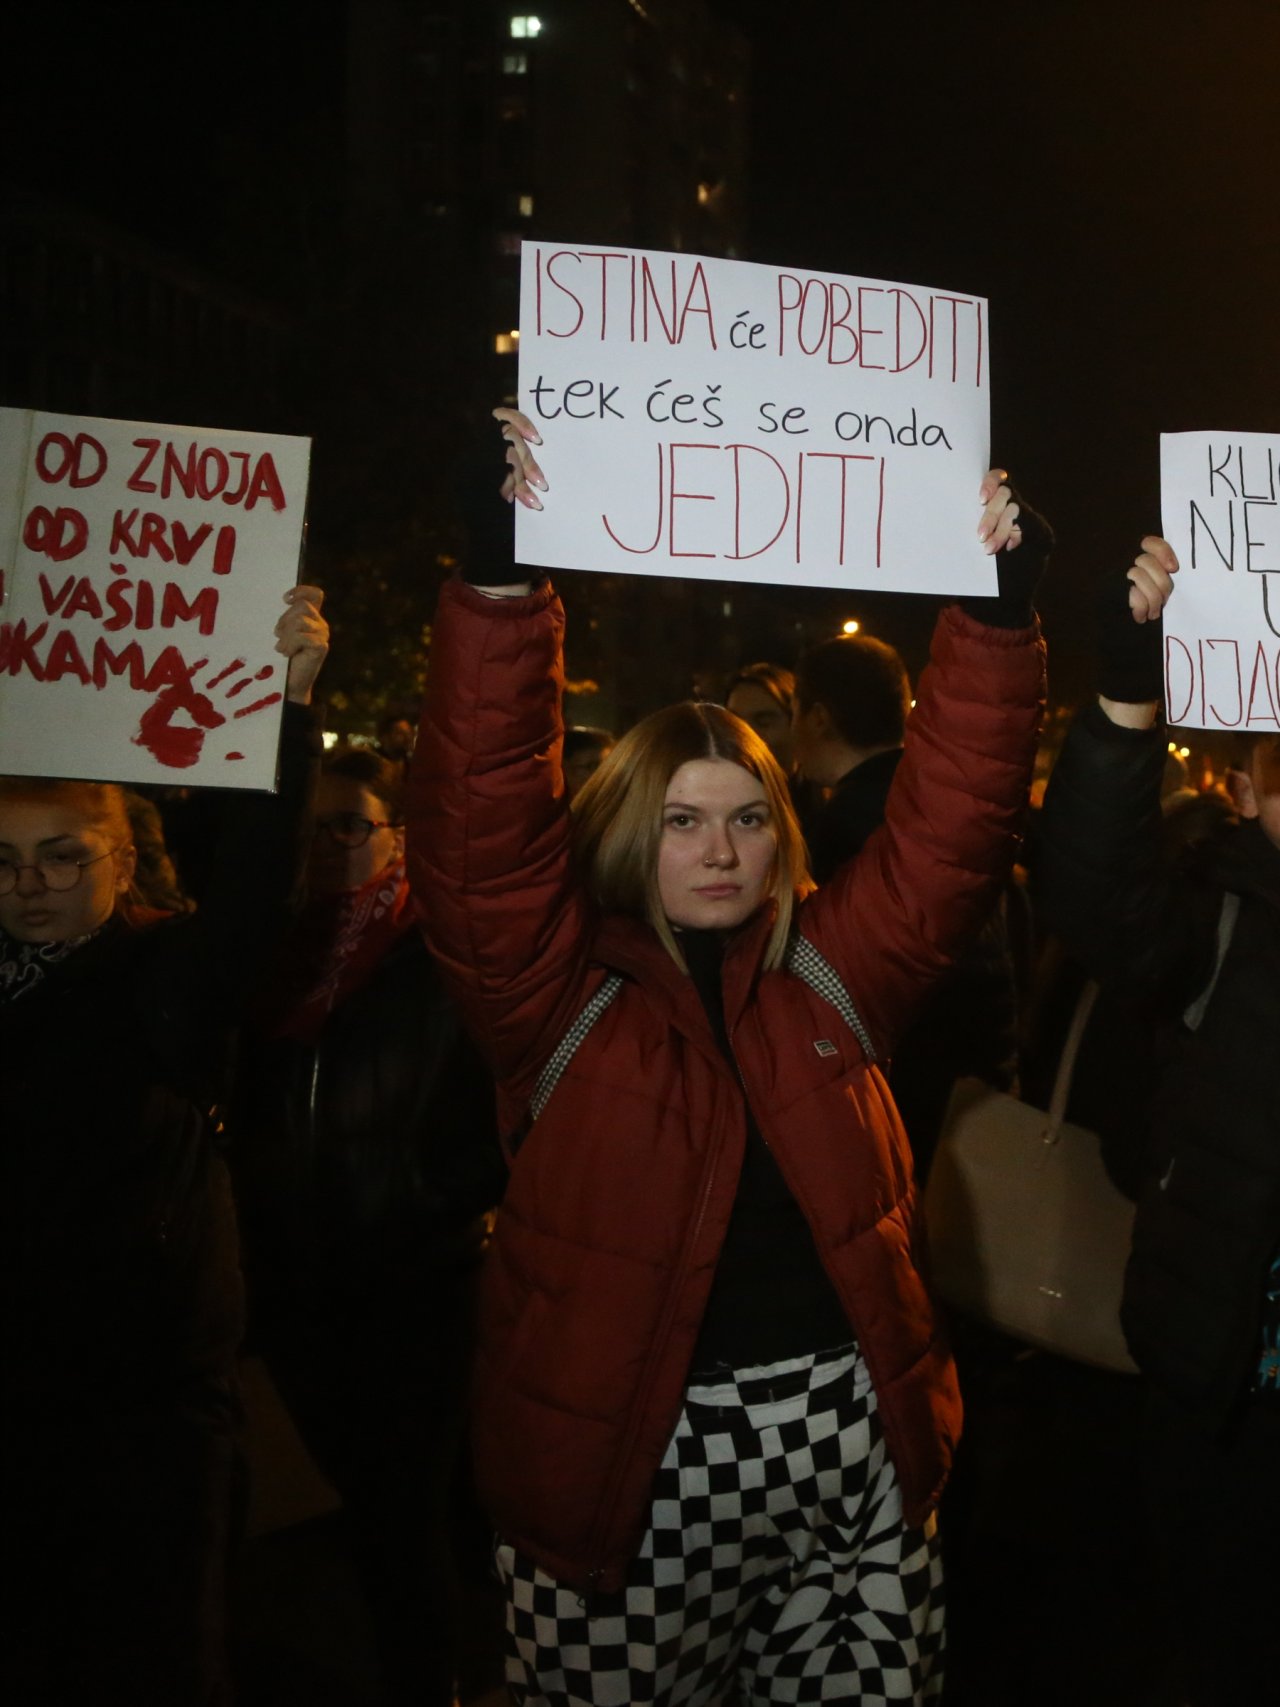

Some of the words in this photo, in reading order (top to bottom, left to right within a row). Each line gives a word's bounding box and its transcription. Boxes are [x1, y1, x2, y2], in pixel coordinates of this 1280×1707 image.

[536, 248, 717, 350] ISTINA
[729, 310, 767, 350] će
[778, 274, 982, 387] POBEDITI
[529, 375, 624, 419] tek
[646, 379, 724, 428] ćeš
[758, 402, 809, 434] se
[834, 408, 953, 451] onda
[36, 432, 107, 488] OD
[127, 438, 286, 512] ZNOJA
[602, 442, 885, 568] JEDITI
[23, 506, 89, 561] OD
[109, 508, 236, 575] KRVI
[38, 563, 219, 636] VAŠIM
